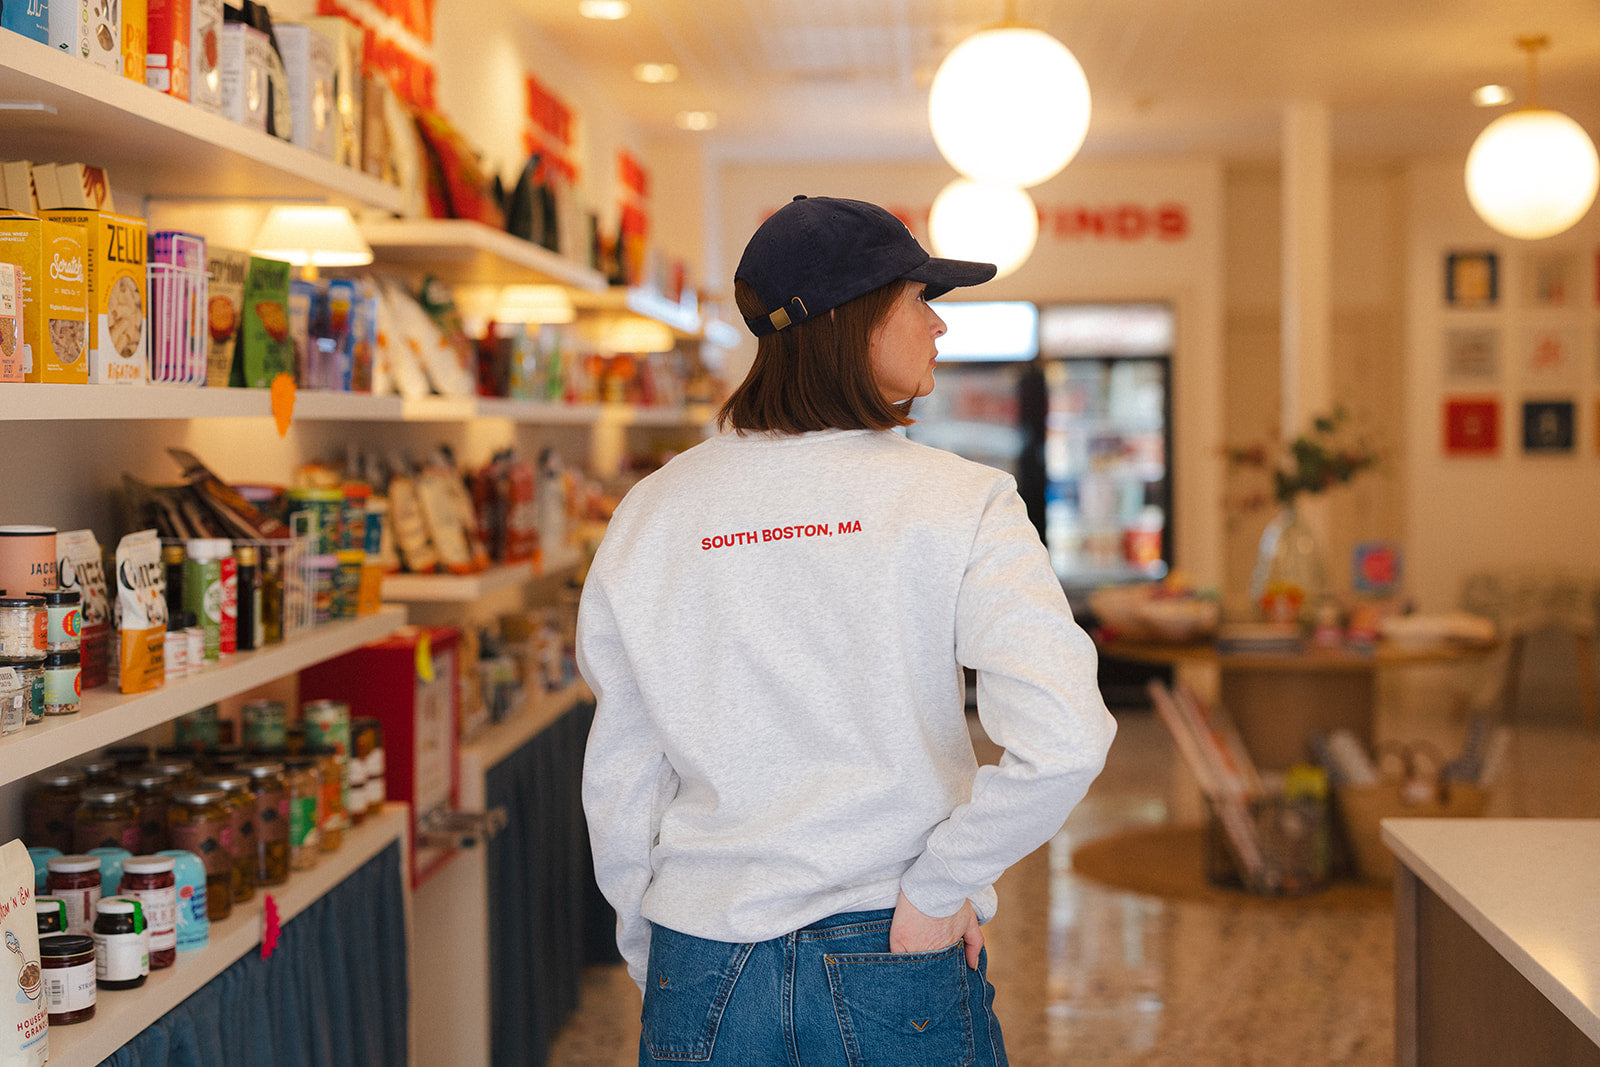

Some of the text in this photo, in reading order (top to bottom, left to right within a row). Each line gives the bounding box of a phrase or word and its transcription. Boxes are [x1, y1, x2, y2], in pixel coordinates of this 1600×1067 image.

[1036, 202, 1191, 243] INDS
[107, 223, 143, 266] ZELLI
[701, 520, 863, 551] SOUTH BOSTON, MA
